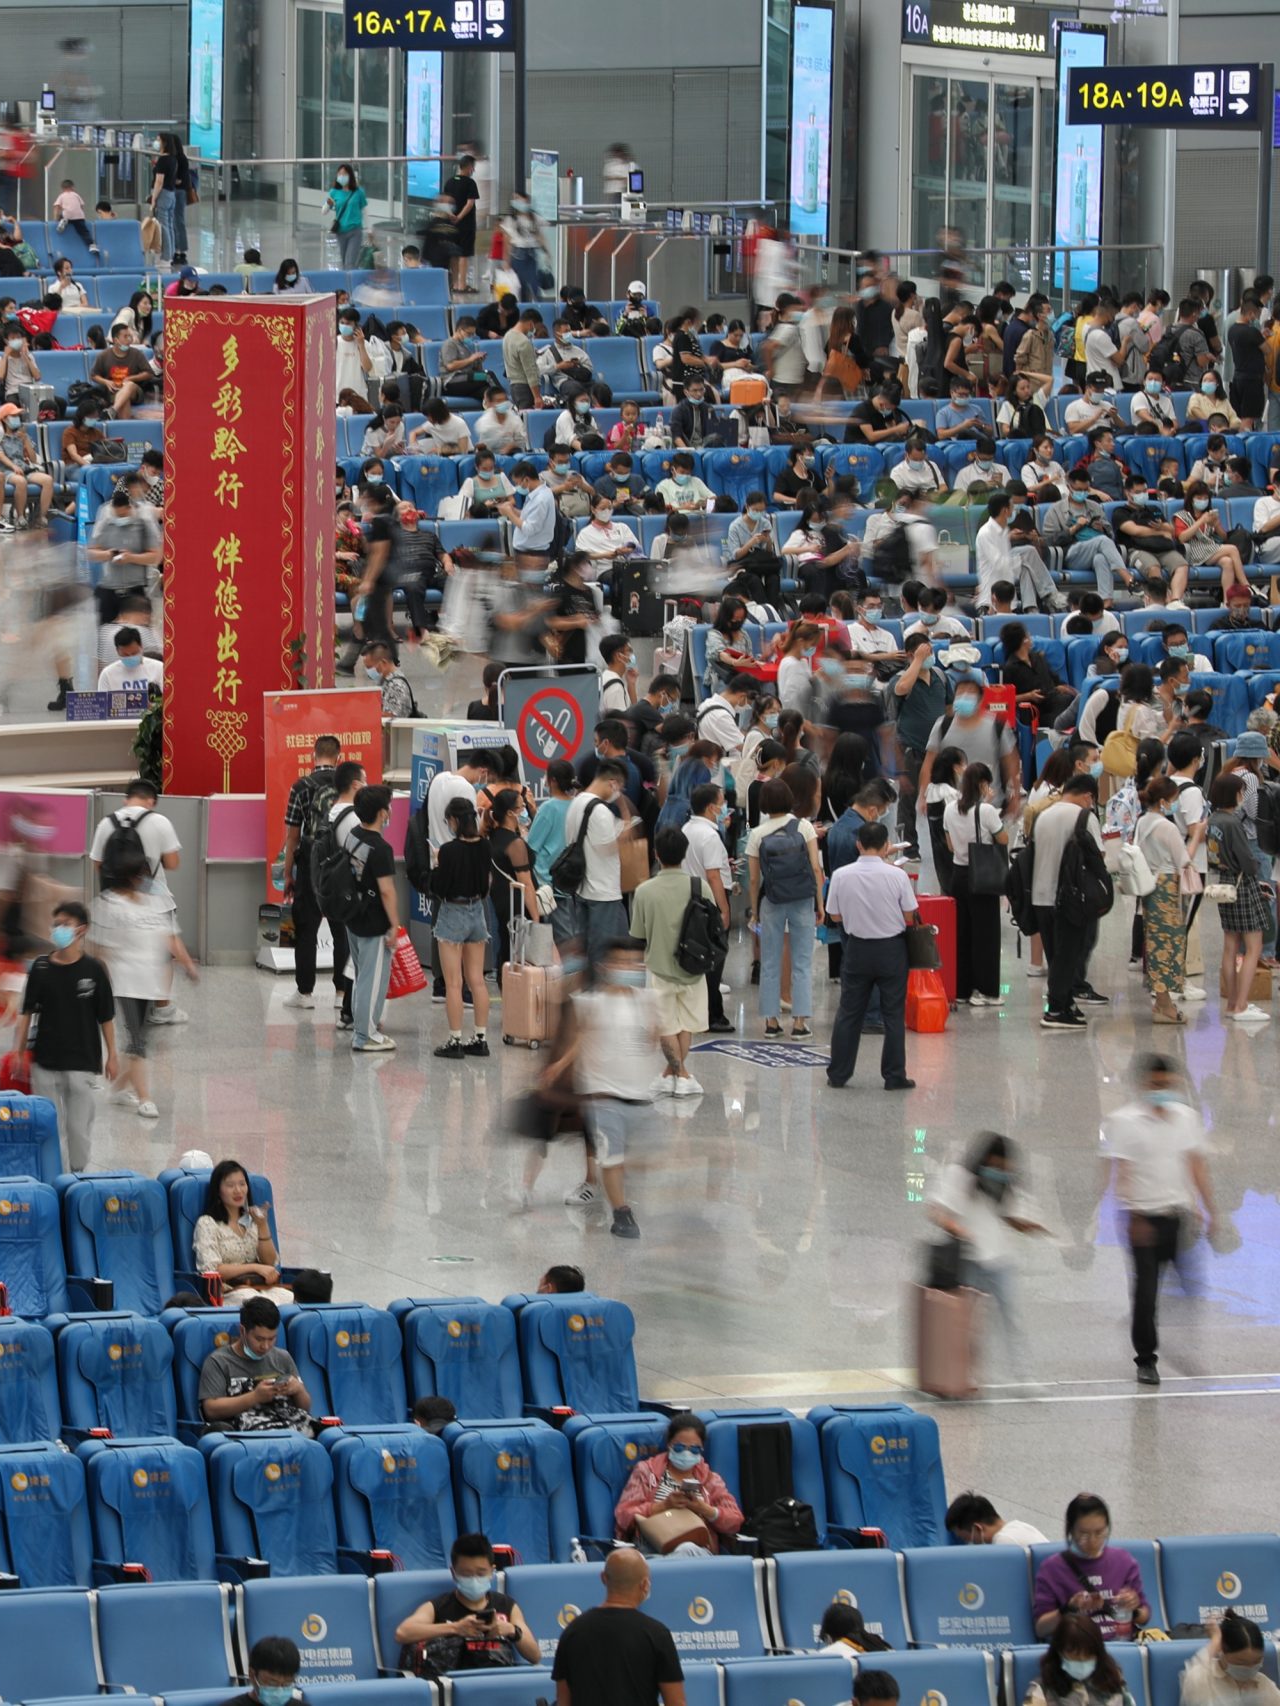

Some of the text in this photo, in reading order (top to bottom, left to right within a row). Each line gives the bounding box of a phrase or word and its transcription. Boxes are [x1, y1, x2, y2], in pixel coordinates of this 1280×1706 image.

[905, 5, 929, 35] 16A
[451, 22, 478, 33] 检票口
[1189, 96, 1219, 109] 检票口
[211, 334, 247, 707] 多彩黔行 伴您出行
[122, 679, 148, 690] CAT
[285, 731, 372, 748] 社会主价值观
[300, 1647, 352, 1660] 电缆集团
